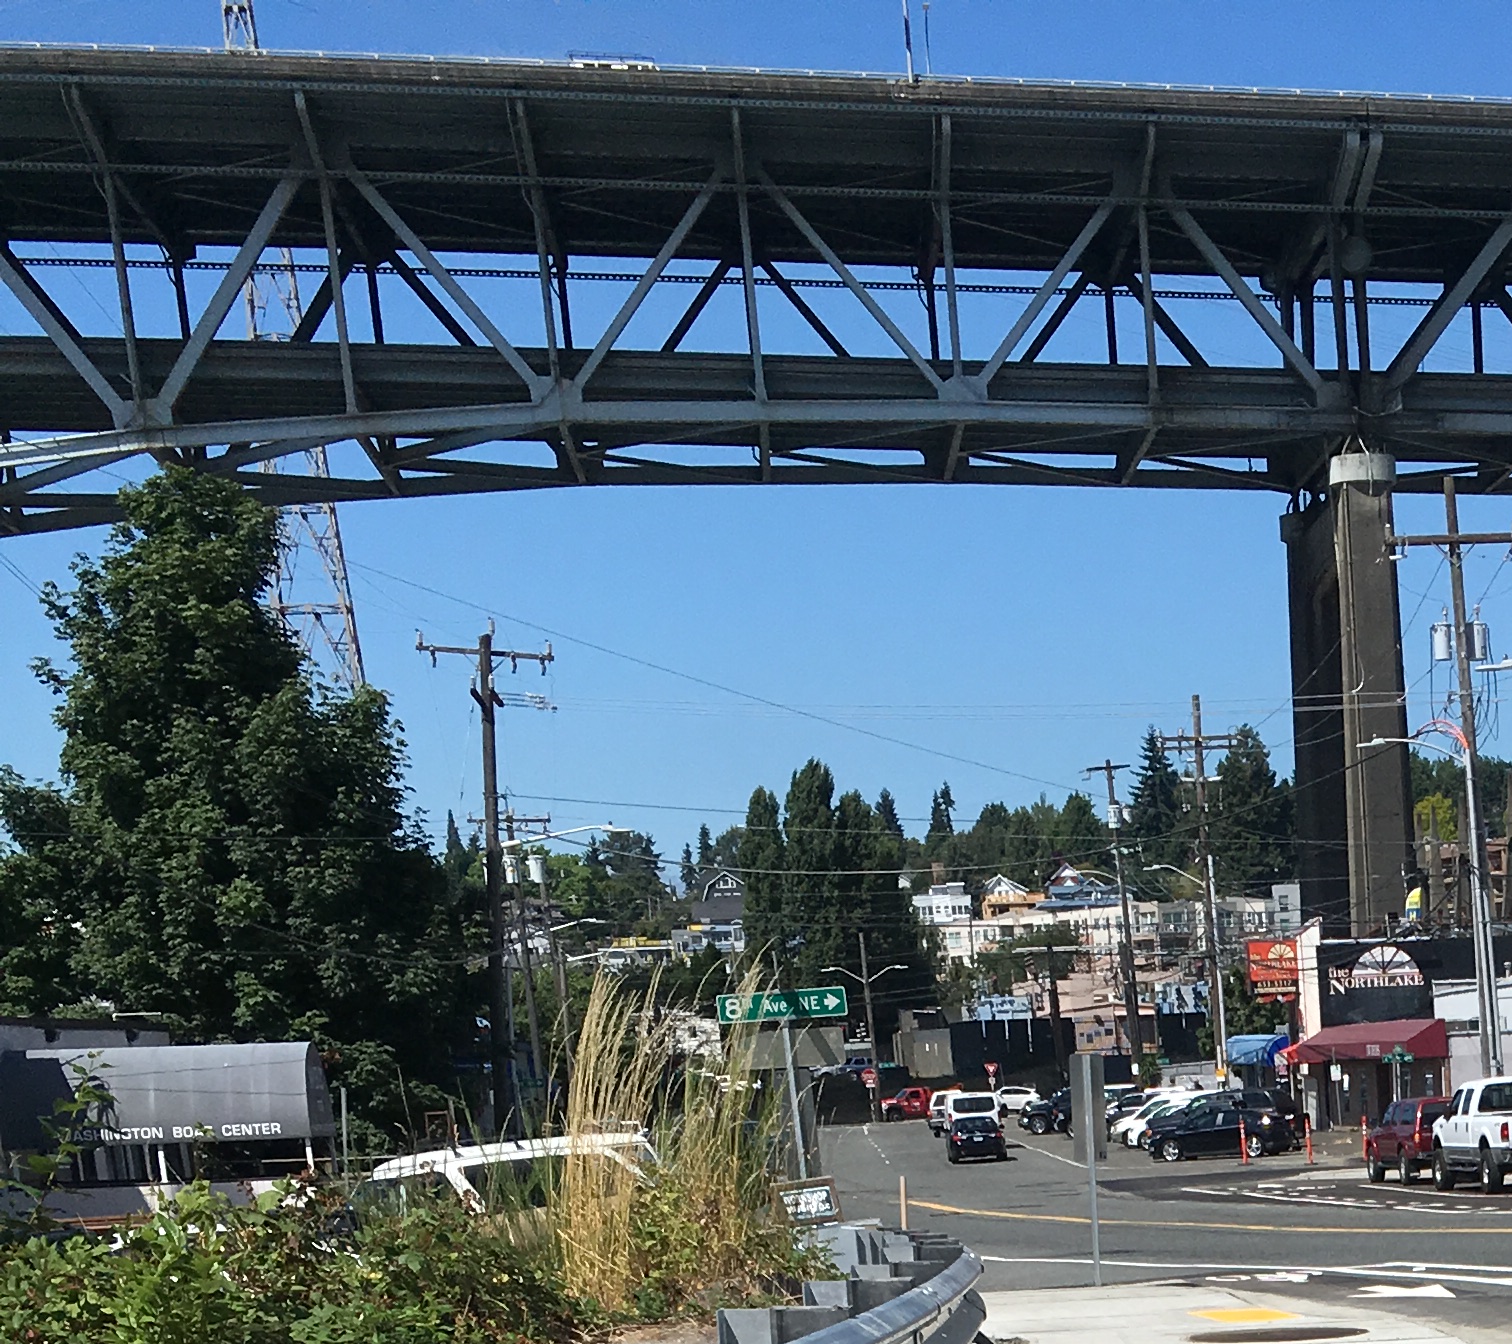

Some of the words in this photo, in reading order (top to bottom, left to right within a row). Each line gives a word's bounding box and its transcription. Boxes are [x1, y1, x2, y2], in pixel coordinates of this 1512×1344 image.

[1328, 967, 1350, 978] the
[1328, 974, 1425, 995] NORTHLAKE
[763, 999, 788, 1014] Ave
[799, 995, 820, 1011] NE
[221, 1122, 282, 1137] CENTER
